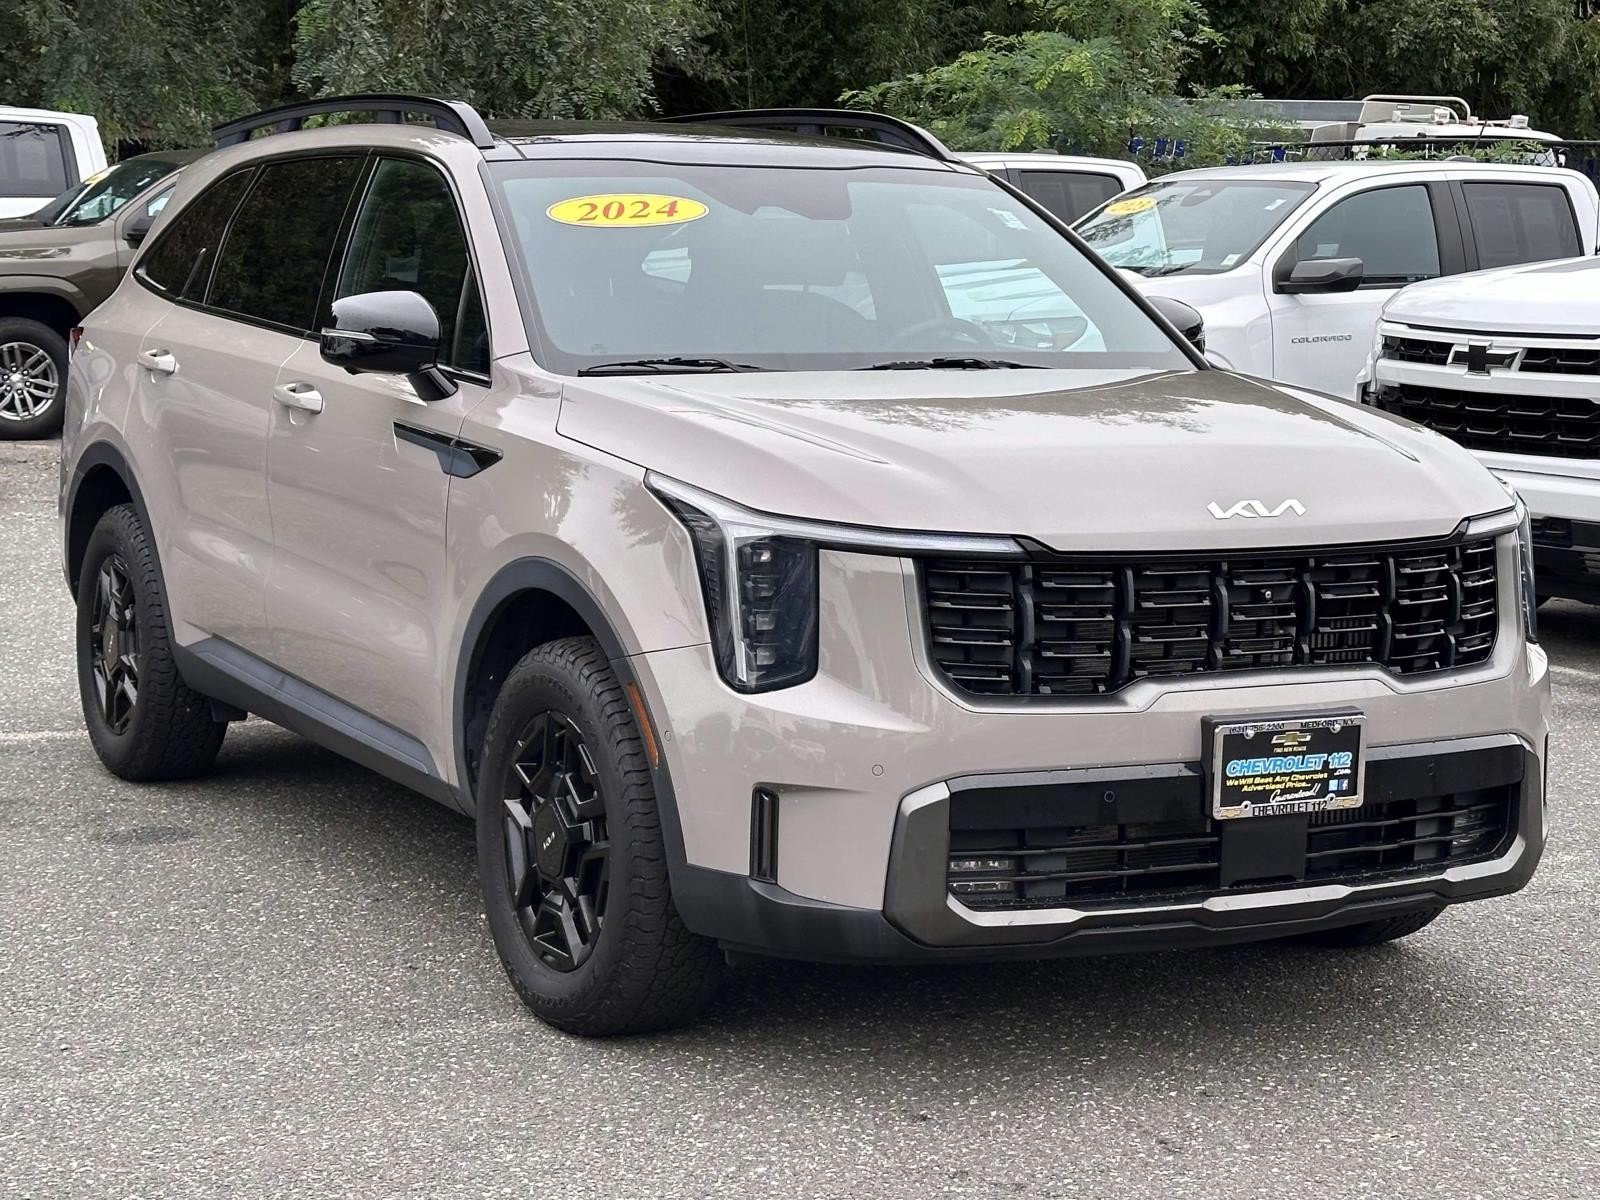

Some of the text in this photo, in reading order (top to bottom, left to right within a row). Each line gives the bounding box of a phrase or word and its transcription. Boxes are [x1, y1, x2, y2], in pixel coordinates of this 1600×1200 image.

[576, 200, 678, 222] 2024
[1291, 334, 1353, 344] COLORADO
[1206, 498, 1307, 520] KIA
[1226, 751, 1353, 778] CHEVROLET 112
[1274, 775, 1291, 783] Any
[1291, 772, 1328, 781] Chevrolet
[1241, 782, 1285, 792] Advertised
[1252, 800, 1328, 817] CHEVROLET 112
